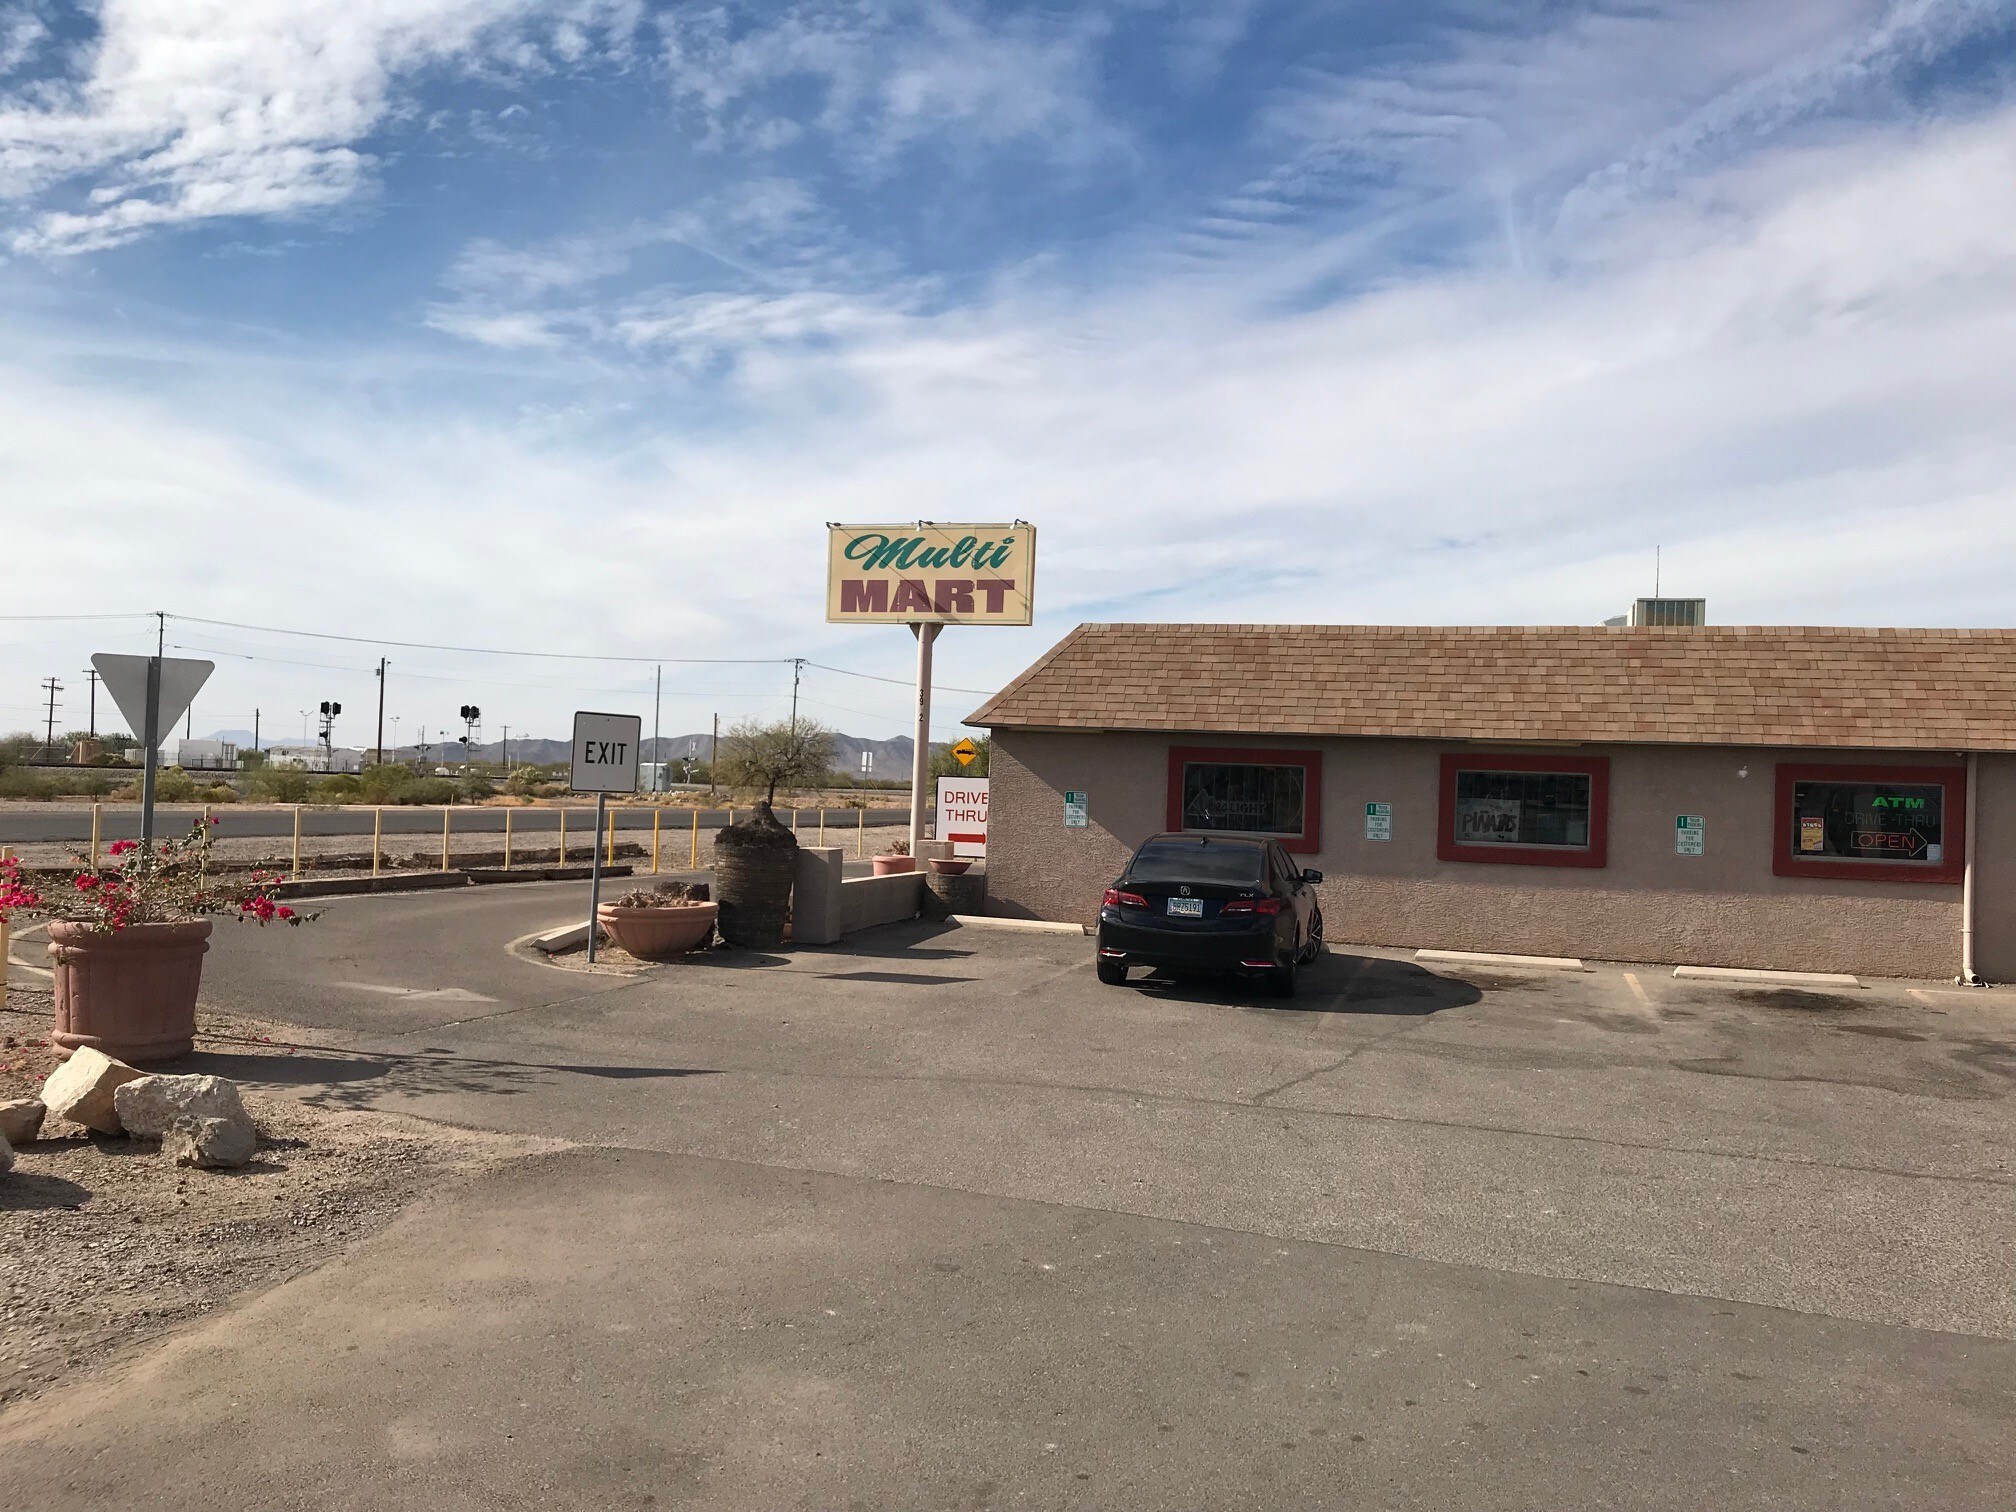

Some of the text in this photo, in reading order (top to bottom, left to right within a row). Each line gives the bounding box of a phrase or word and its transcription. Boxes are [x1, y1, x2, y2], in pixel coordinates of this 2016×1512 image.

[844, 534, 1015, 571] Multi
[841, 579, 1015, 613] MART
[585, 741, 627, 765] EXIT
[944, 791, 988, 805] DRIVE
[1872, 796, 1925, 809] ATM
[945, 809, 988, 823] THRU
[1858, 834, 1915, 849] OPEN
